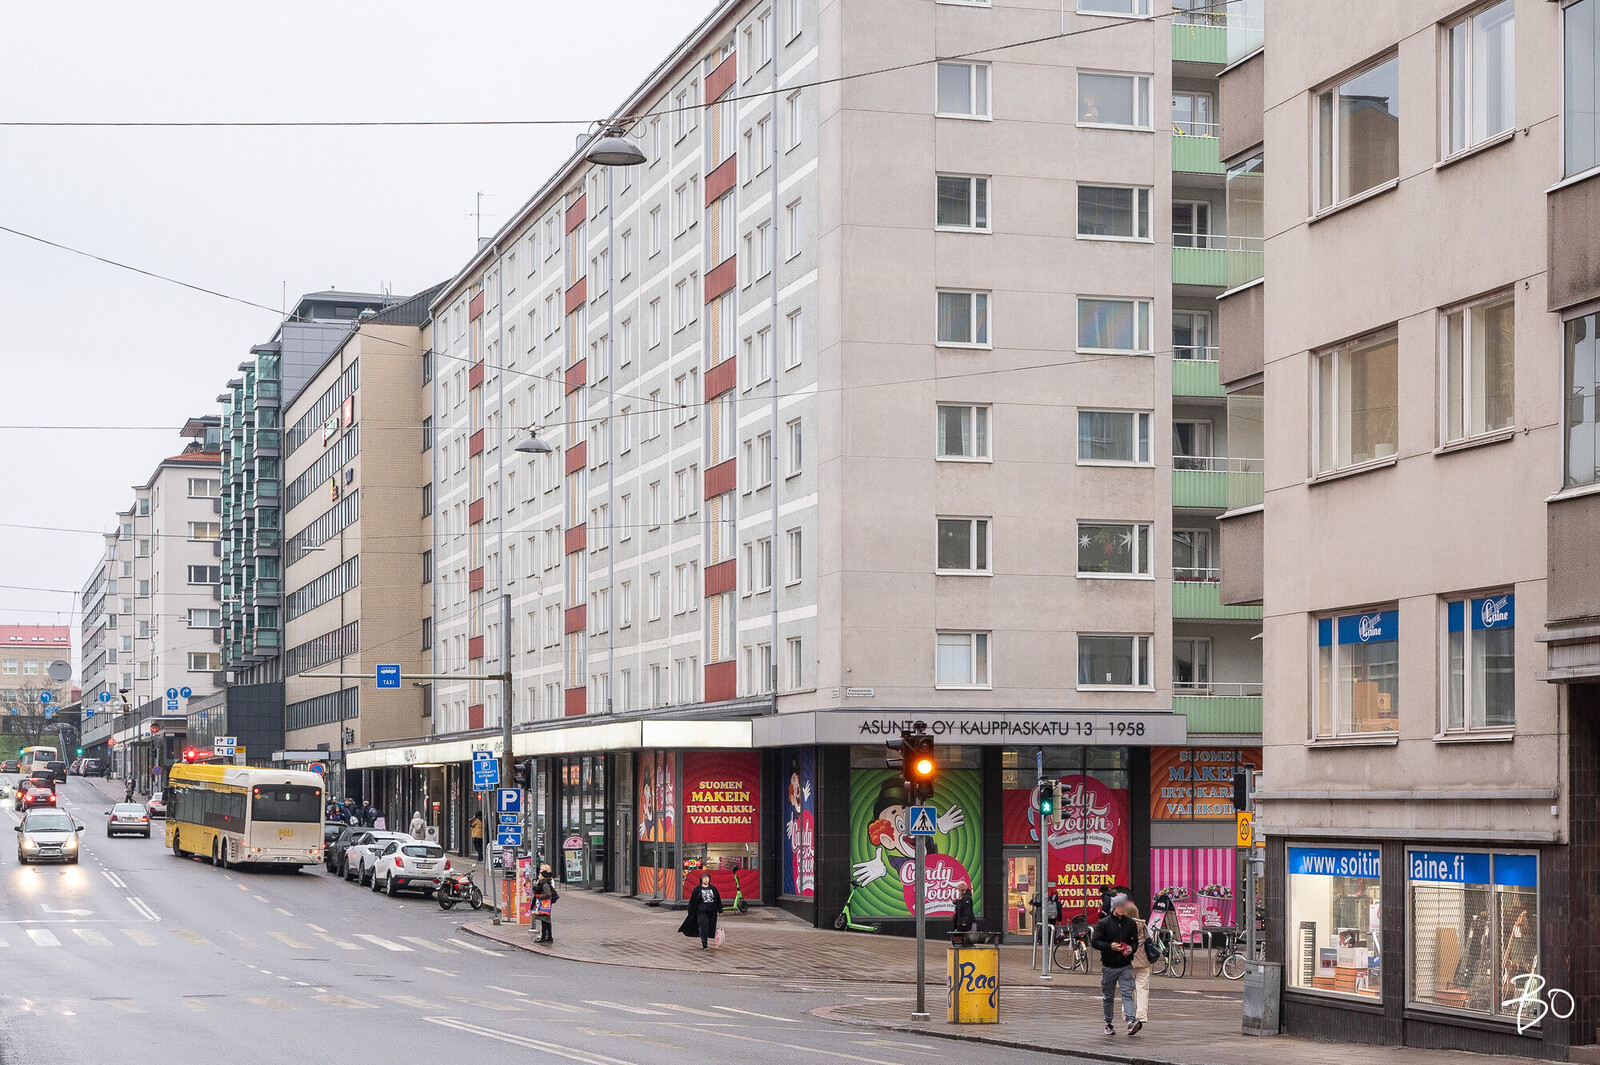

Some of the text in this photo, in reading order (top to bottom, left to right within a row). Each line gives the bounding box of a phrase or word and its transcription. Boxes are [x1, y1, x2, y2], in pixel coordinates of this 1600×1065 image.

[932, 720, 955, 735] OY
[960, 721, 1069, 736] KAUPPIASKATU
[1076, 722, 1093, 736] 13
[1108, 722, 1145, 736] 1958
[1180, 751, 1243, 762] SUOMEN
[699, 781, 743, 789] SUOMEN
[691, 791, 750, 802] MAKEIN
[686, 805, 756, 813] IRTOKARKKI-
[690, 816, 752, 824] VALIKOIMA!
[1241, 823, 1248, 836] 20
[1065, 864, 1109, 872] SUOMEN
[1410, 853, 1465, 881] laine.fi
[1057, 874, 1116, 885] MAKEIN
